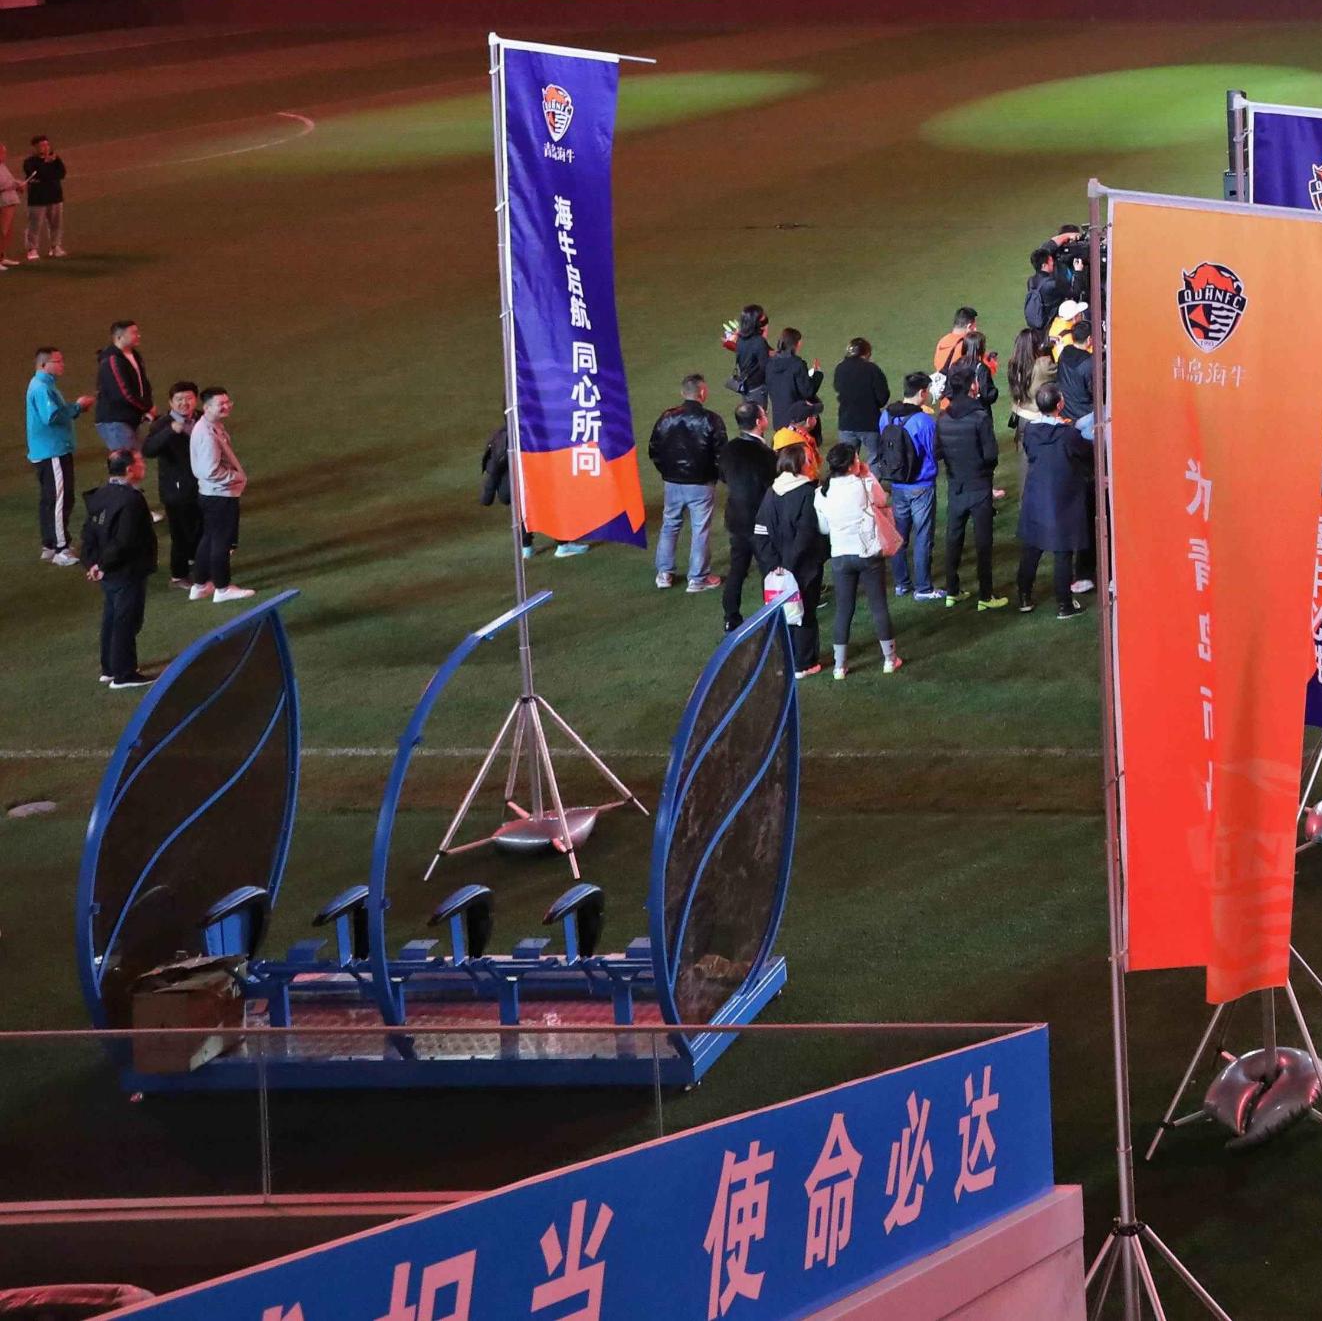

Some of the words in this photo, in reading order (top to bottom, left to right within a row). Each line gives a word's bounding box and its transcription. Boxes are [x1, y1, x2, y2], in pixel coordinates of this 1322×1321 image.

[553, 194, 592, 331] 海牛启航
[570, 341, 603, 477] 同心所向
[1173, 356, 1247, 387] 青岛海牛
[703, 1064, 1001, 1321] 使命必达
